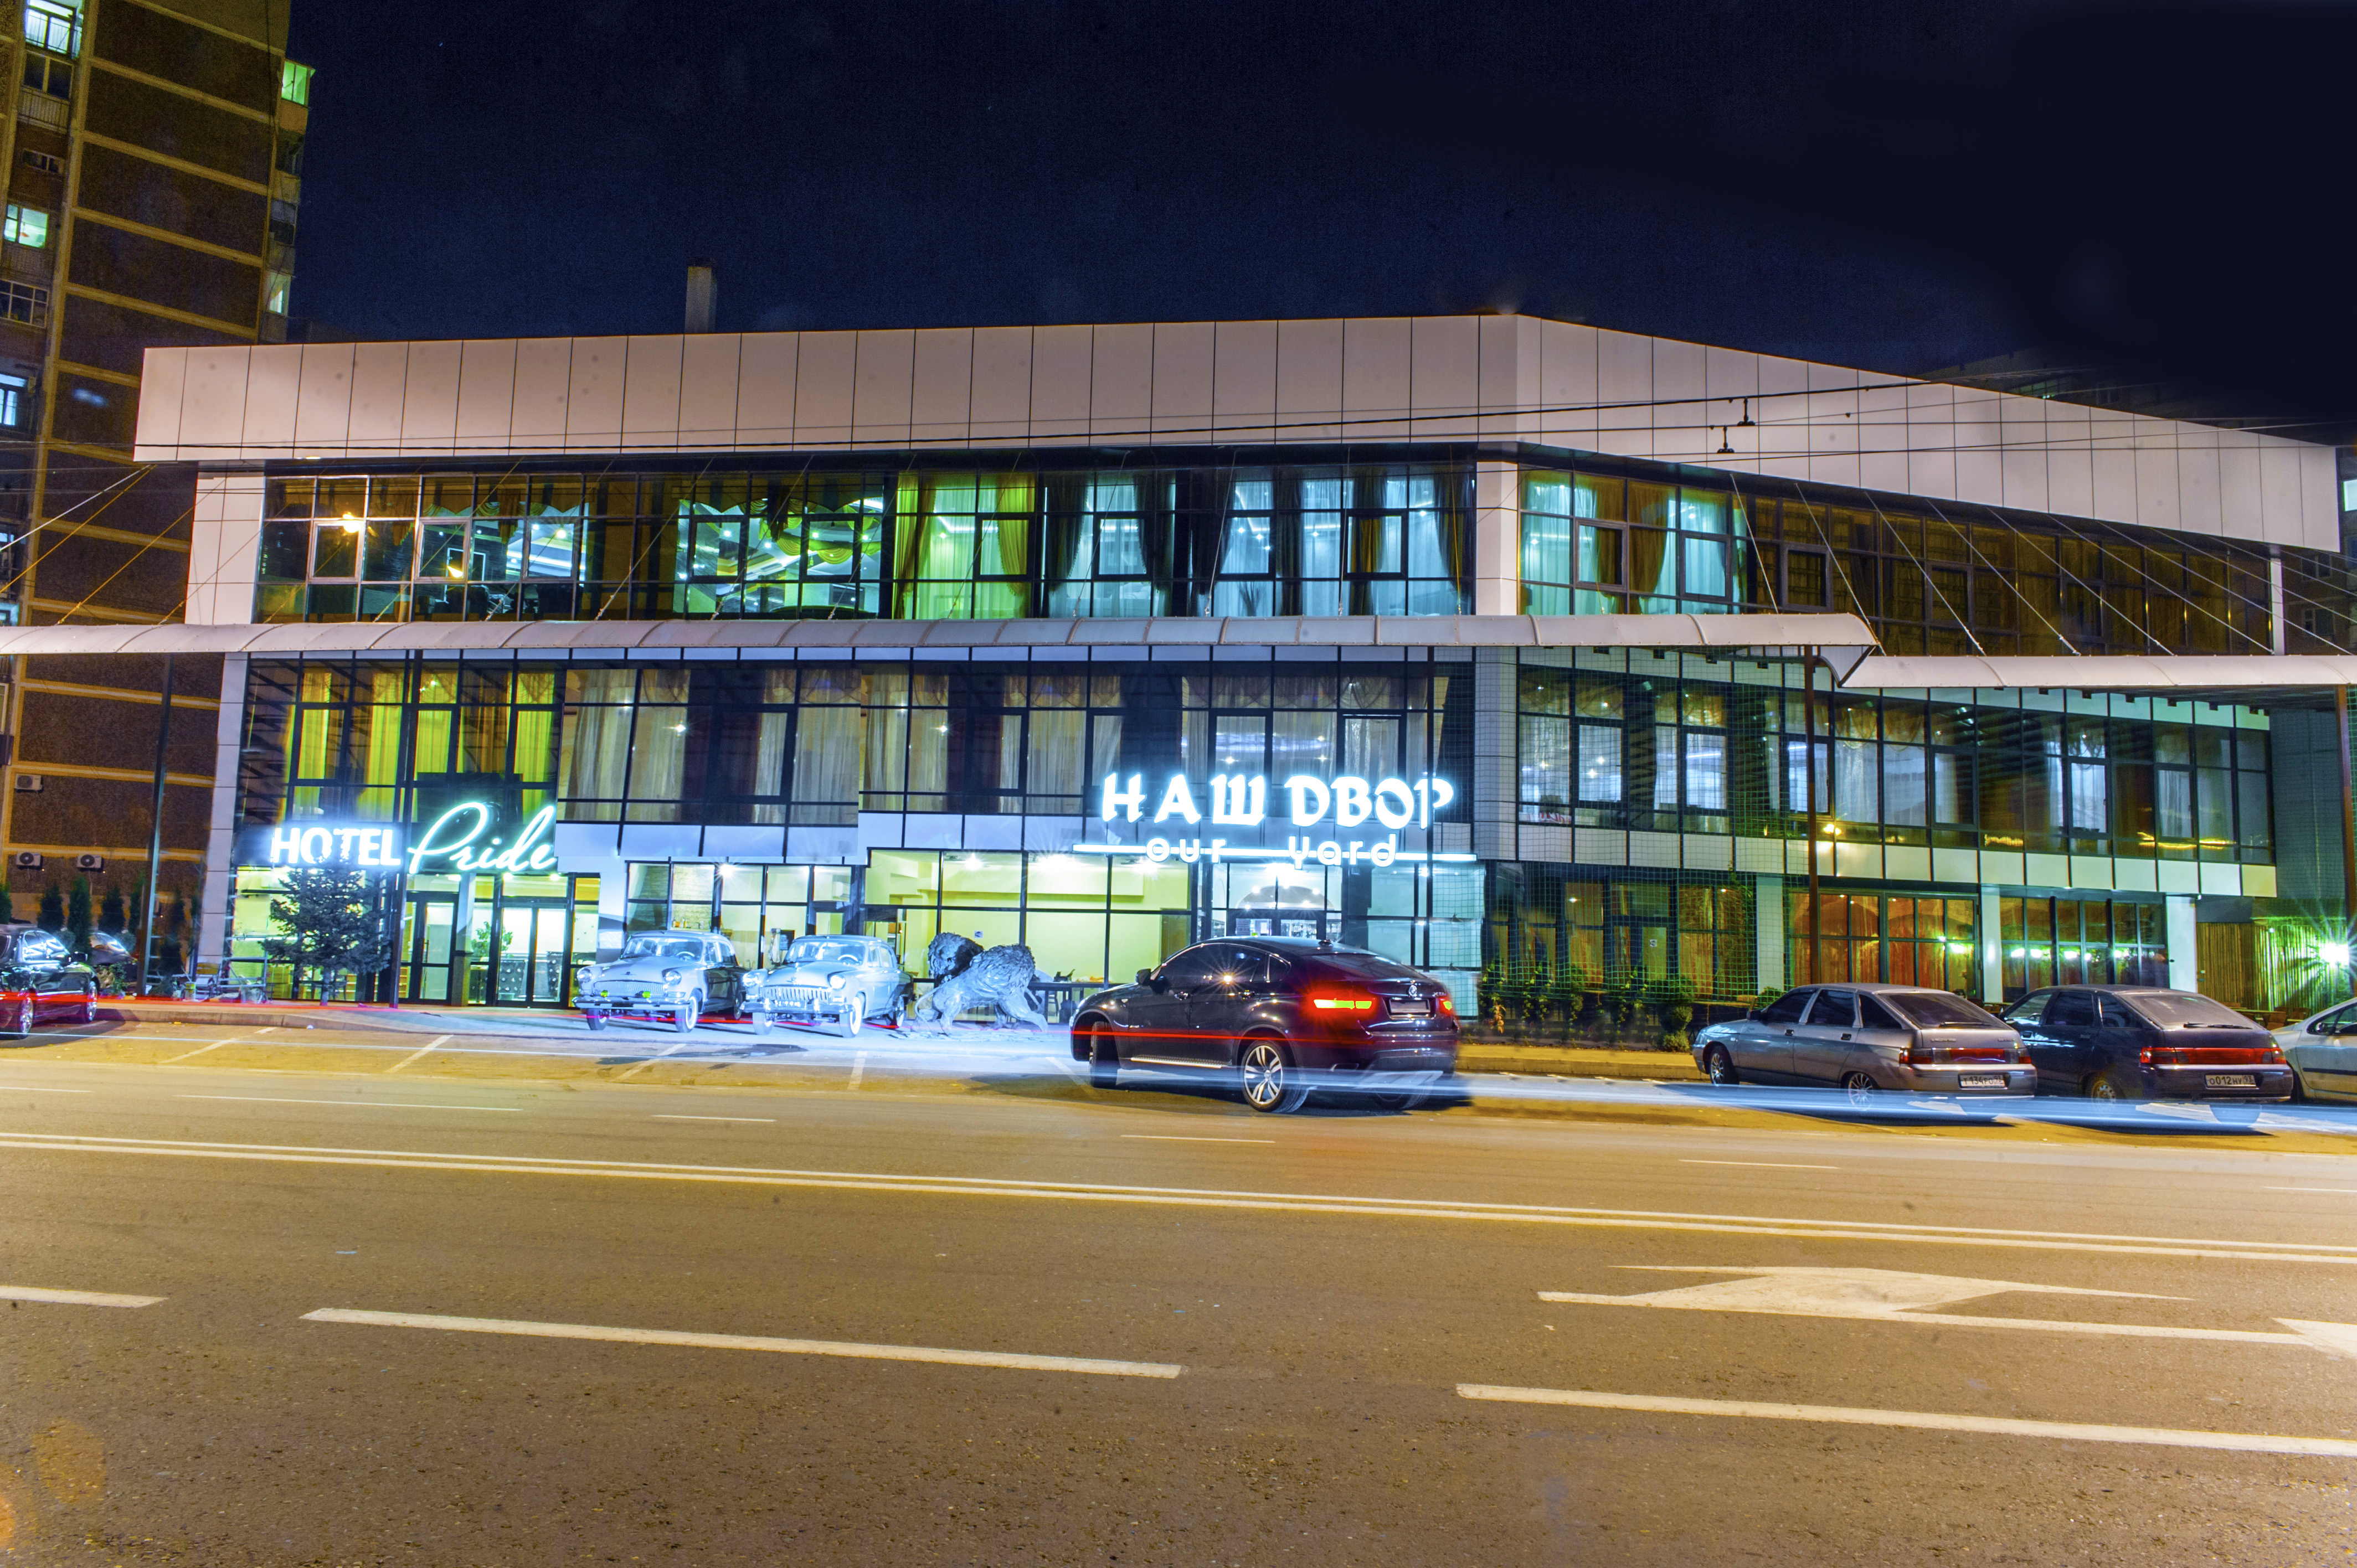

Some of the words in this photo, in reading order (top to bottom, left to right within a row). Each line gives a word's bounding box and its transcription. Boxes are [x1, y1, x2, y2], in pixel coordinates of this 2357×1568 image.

[270, 827, 401, 865] HOTEL
[407, 802, 557, 874] Pride
[1146, 837, 1227, 863] our
[1288, 833, 1396, 869] yard
